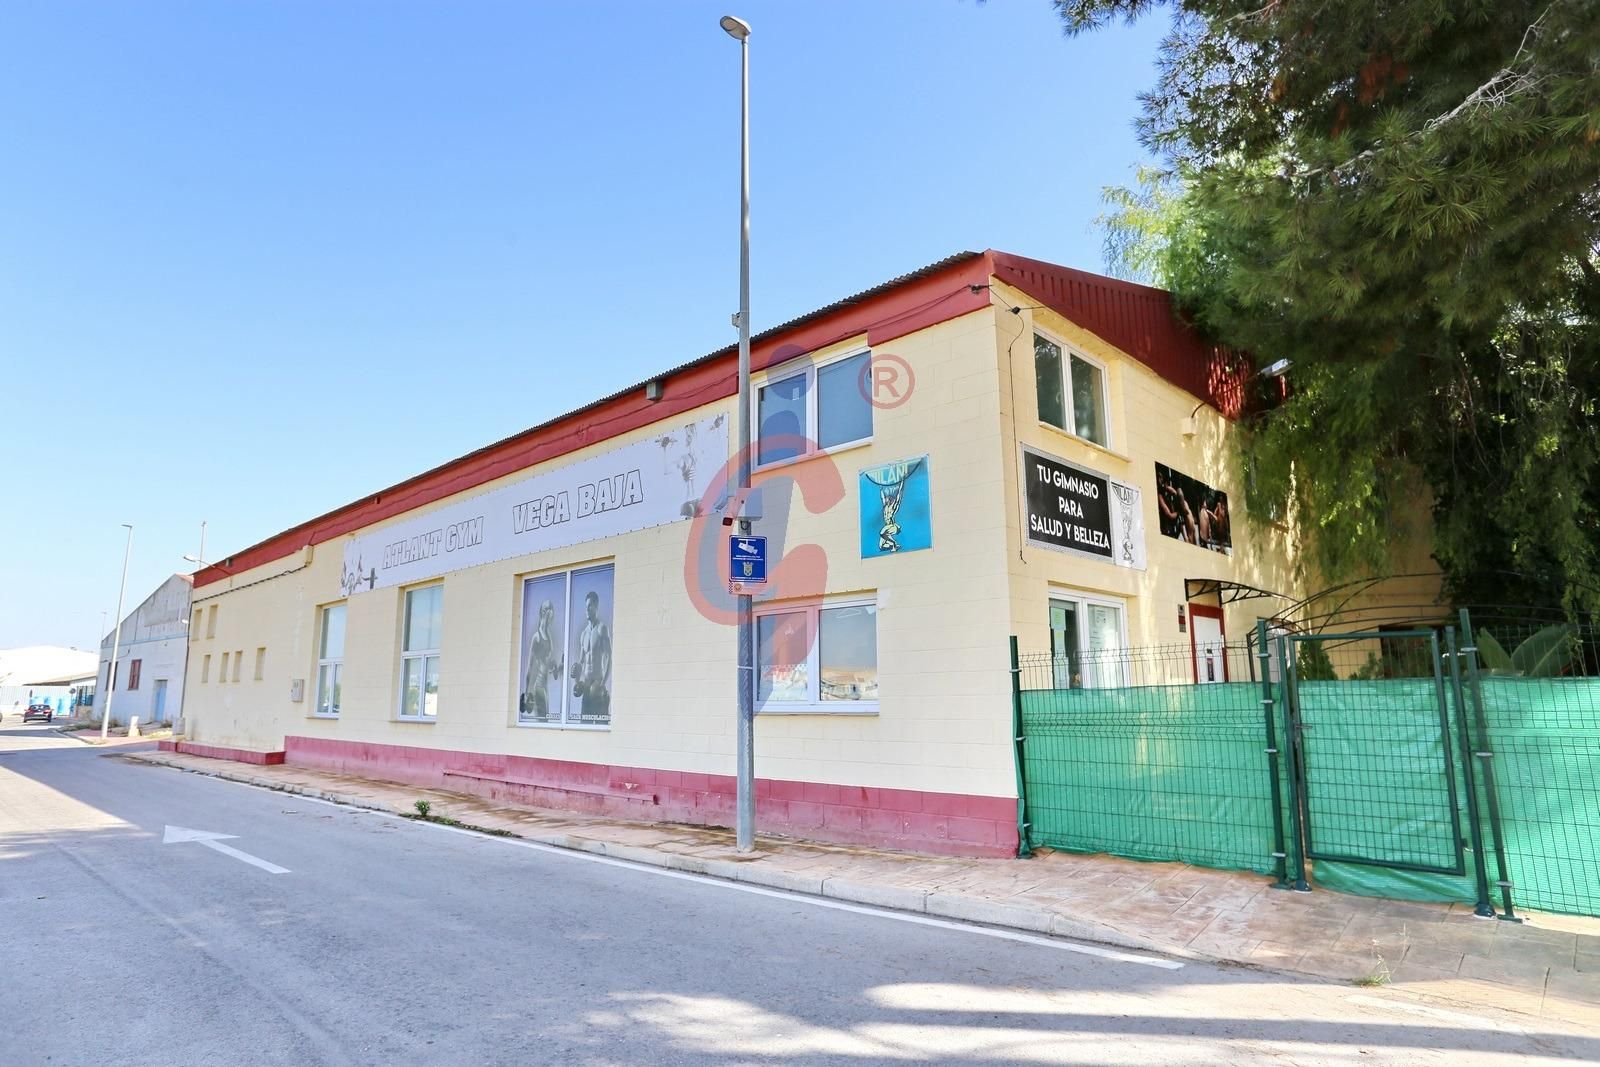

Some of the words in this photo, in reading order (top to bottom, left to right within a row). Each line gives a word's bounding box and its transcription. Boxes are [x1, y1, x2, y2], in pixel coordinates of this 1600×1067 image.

[1036, 464, 1051, 484] TU
[1053, 470, 1099, 499] GIMNASIO
[382, 528, 443, 570] ATLANT
[445, 516, 484, 552] GYM
[512, 490, 571, 535] VEGA
[577, 468, 643, 518] BAJA
[1058, 496, 1084, 519] PARA
[1030, 513, 1063, 537] SALUD
[1064, 522, 1071, 540] Y
[1073, 525, 1110, 550] BELLEZA
